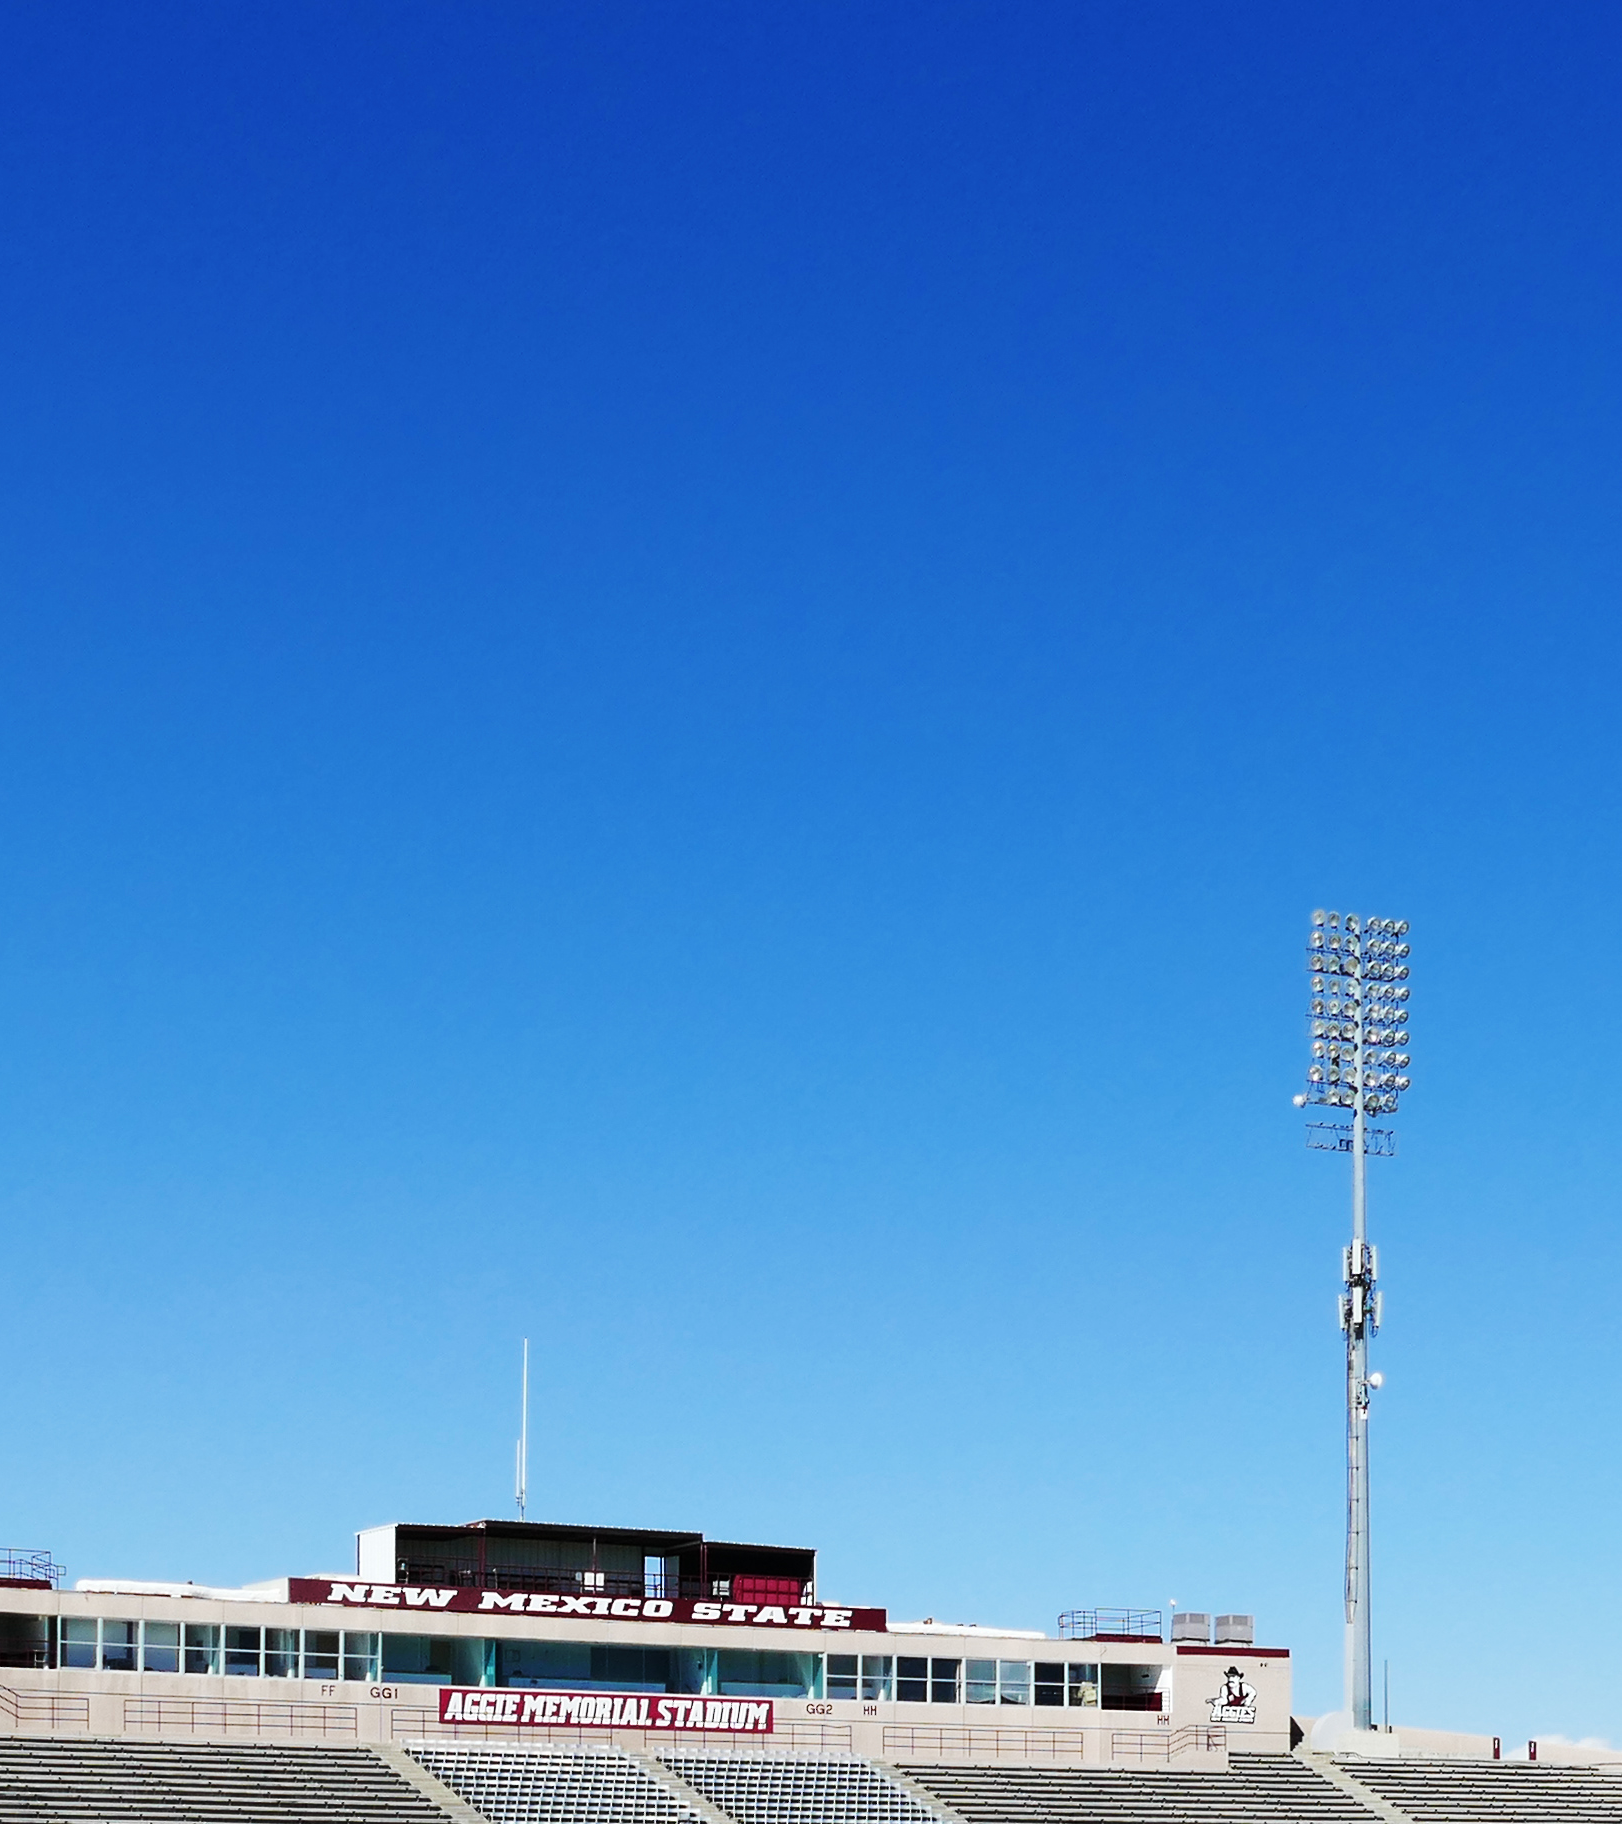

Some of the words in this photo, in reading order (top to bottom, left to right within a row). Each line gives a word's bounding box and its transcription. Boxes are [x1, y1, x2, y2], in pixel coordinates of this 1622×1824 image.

[326, 1583, 459, 1607] NEW
[478, 1590, 673, 1618] MEXICO
[690, 1602, 855, 1628] STATE
[321, 1685, 335, 1696] FF
[444, 1692, 521, 1723] AGGIE
[522, 1695, 652, 1727] MEMORIAL
[656, 1700, 770, 1730] STADIUM
[806, 1704, 833, 1715] GG2
[863, 1705, 877, 1716] HH
[1211, 1703, 1256, 1718] AGGIES
[1157, 1715, 1169, 1725] HH
